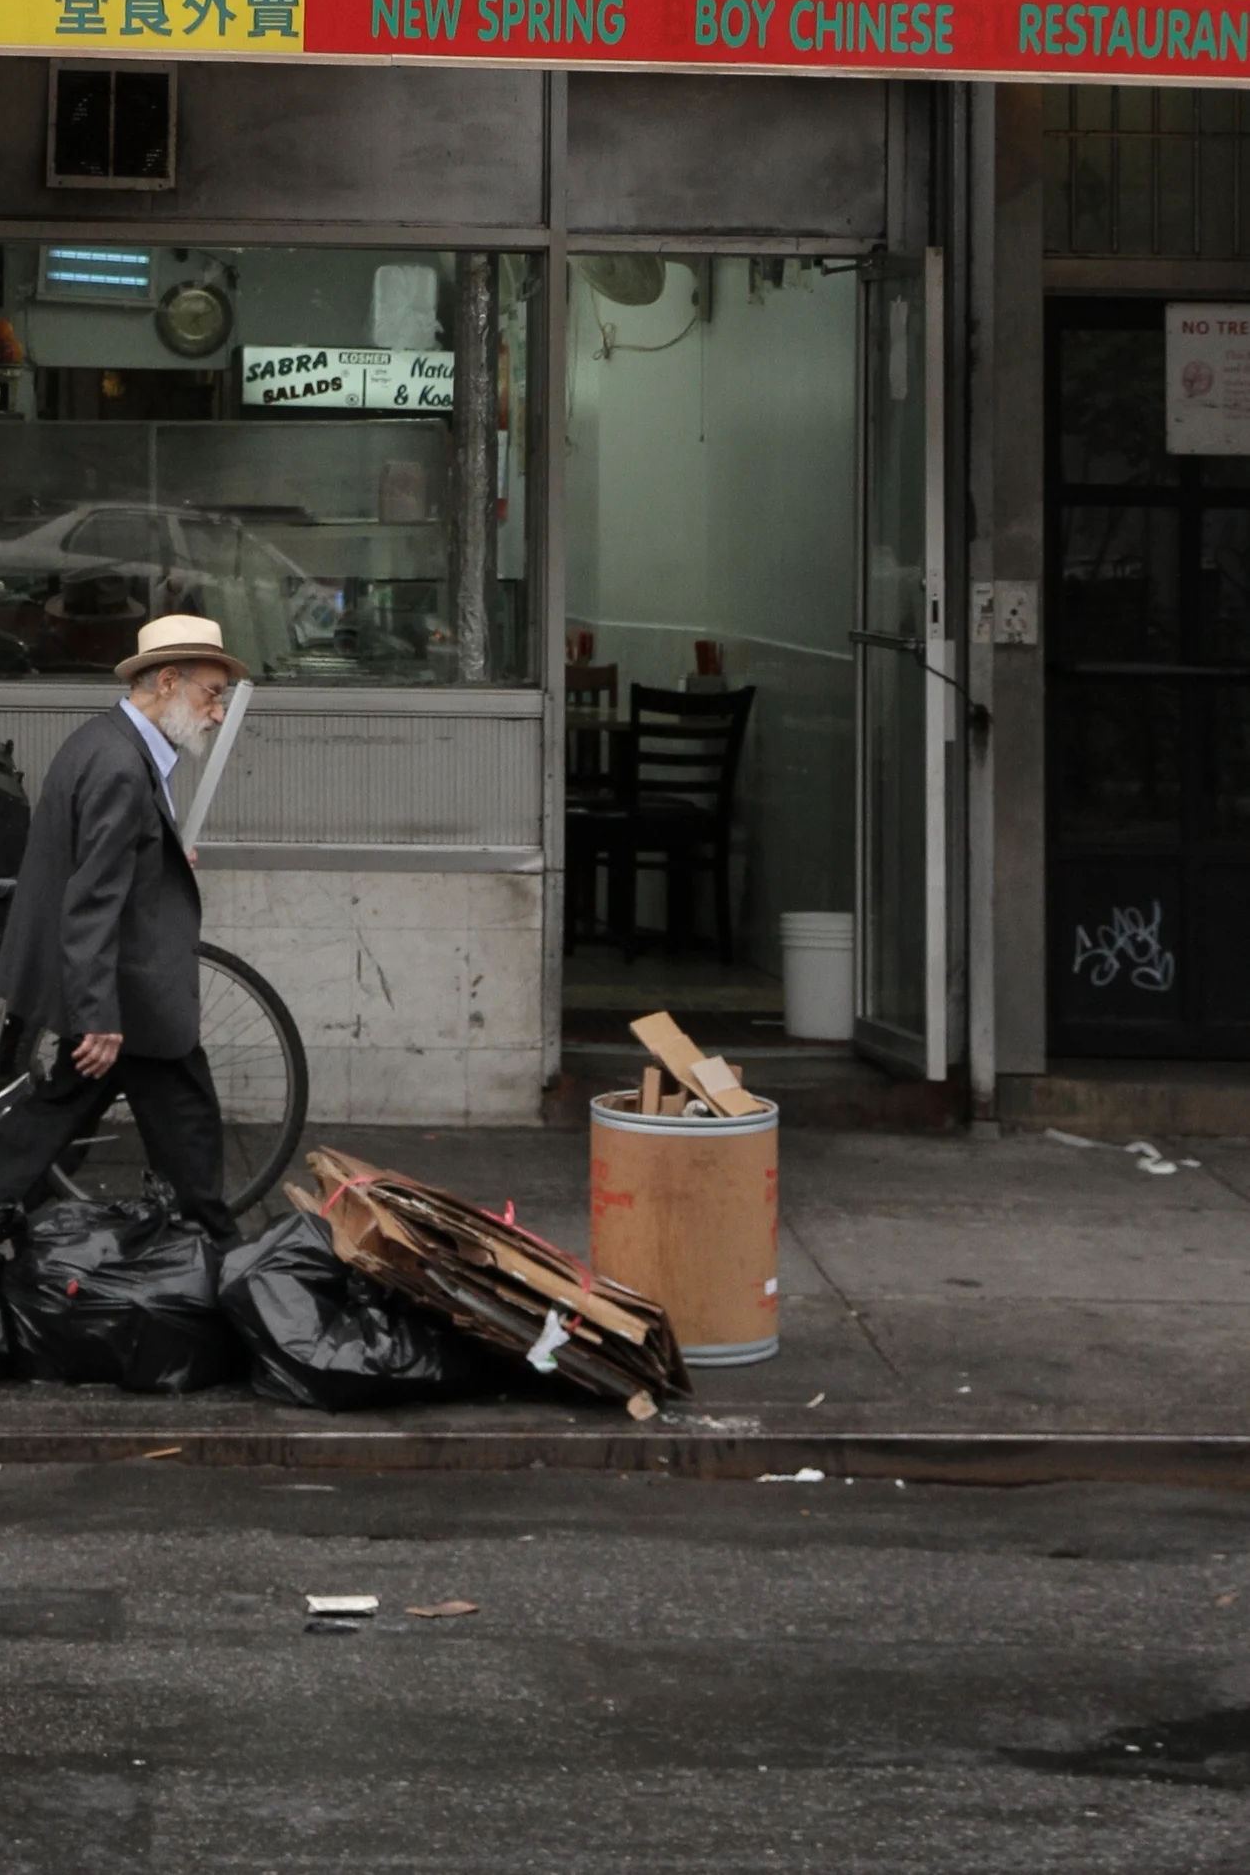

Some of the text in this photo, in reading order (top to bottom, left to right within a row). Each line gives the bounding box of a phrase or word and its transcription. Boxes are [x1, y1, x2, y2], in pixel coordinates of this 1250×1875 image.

[1019, 3, 1248, 61] RESTAURAN
[1182, 320, 1210, 335] NO
[246, 351, 328, 383] SABRA
[339, 352, 390, 365] KOSHER
[263, 377, 343, 405] SALADS
[394, 384, 409, 406] &
